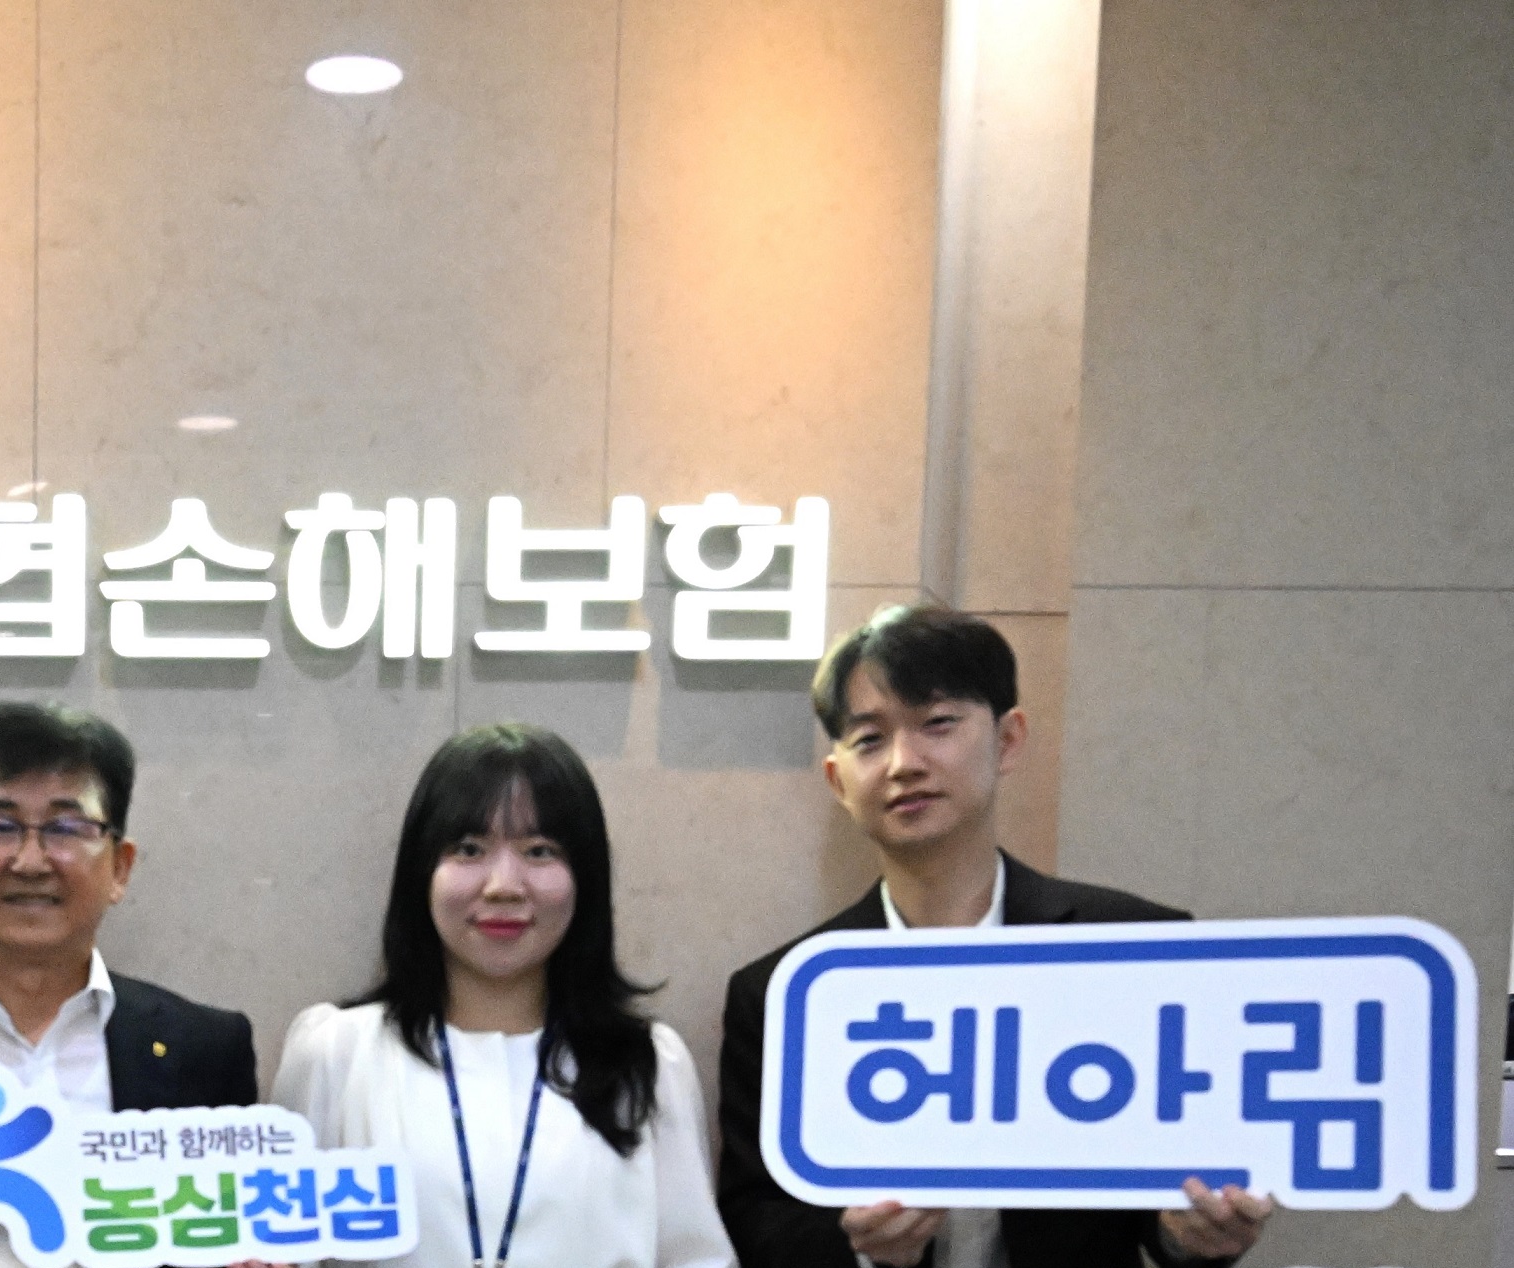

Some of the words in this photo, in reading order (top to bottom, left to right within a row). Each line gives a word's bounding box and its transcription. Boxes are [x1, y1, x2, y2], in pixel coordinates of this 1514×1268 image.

[846, 1000, 1384, 1192] 헤아림
[79, 1127, 168, 1162] 국민과
[179, 1124, 295, 1159] 함께하는
[83, 1164, 401, 1253] 농심천심
